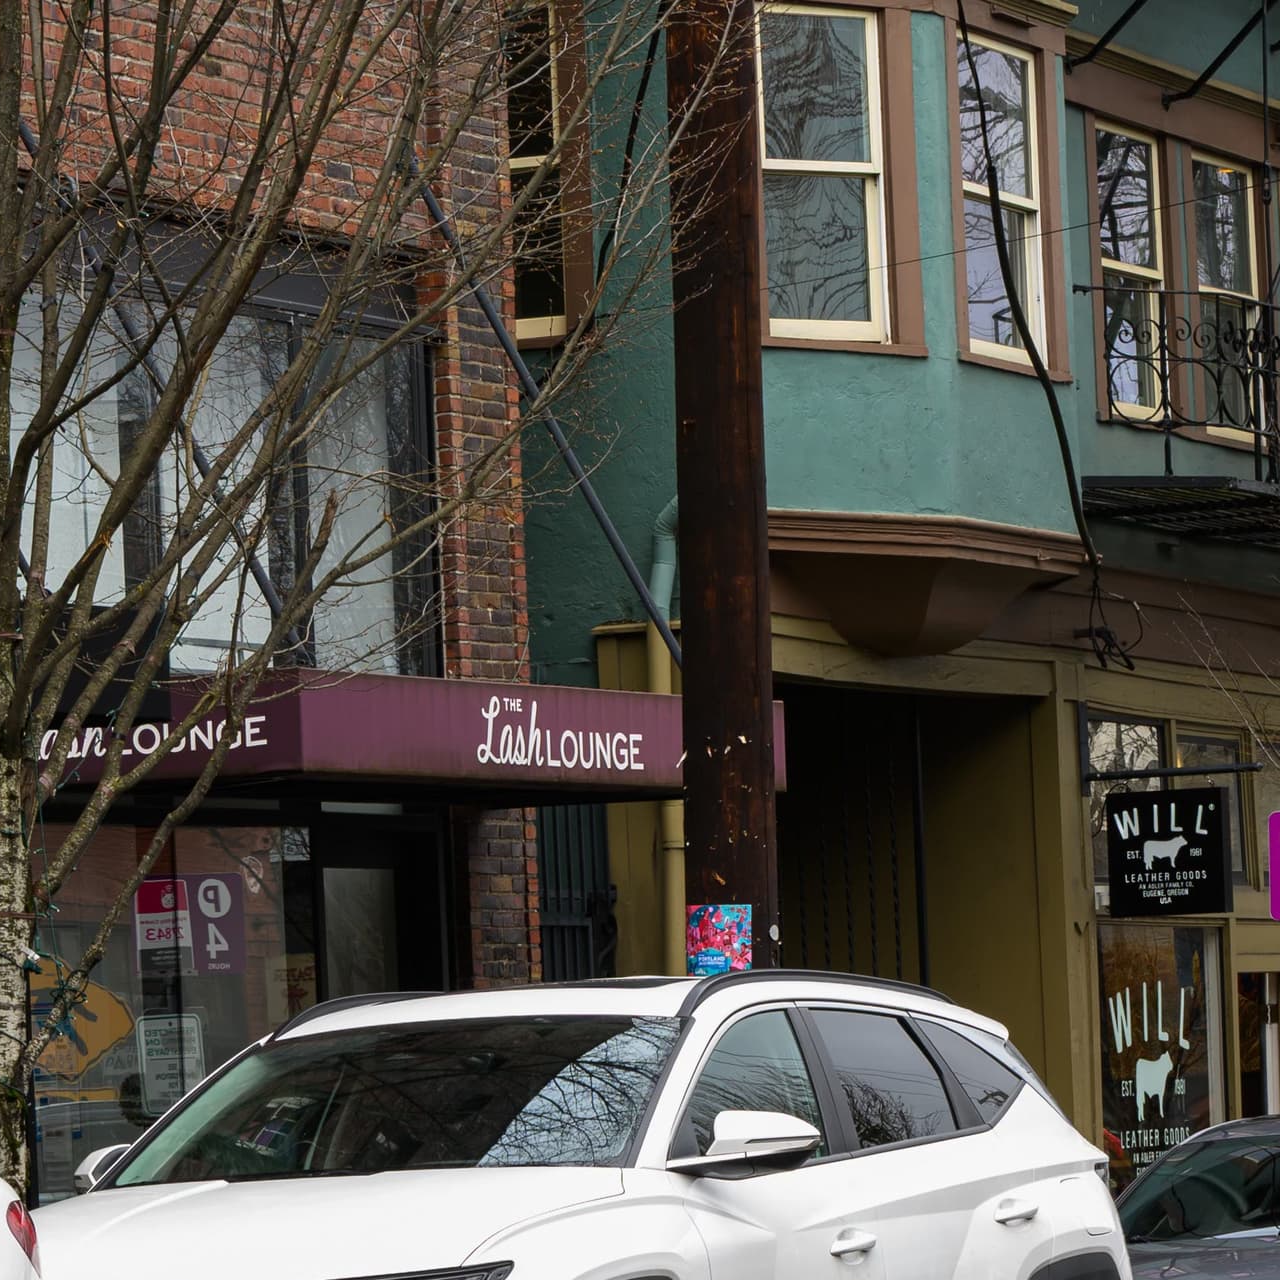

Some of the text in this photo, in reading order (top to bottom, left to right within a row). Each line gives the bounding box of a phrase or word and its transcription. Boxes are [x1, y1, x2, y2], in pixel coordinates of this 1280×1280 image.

[503, 697, 523, 712] THE
[477, 695, 645, 771] Lash LOUNGE
[1113, 802, 1208, 840] WILL
[1126, 850, 1142, 860] EST.
[1125, 870, 1208, 883] LEATHER GOODS
[1167, 888, 1189, 896] OREGON
[1109, 980, 1190, 1054] WILL
[1121, 1080, 1135, 1097] EST.
[1120, 1128, 1160, 1149] LEATHER
[1133, 1152, 1140, 1164] AN
